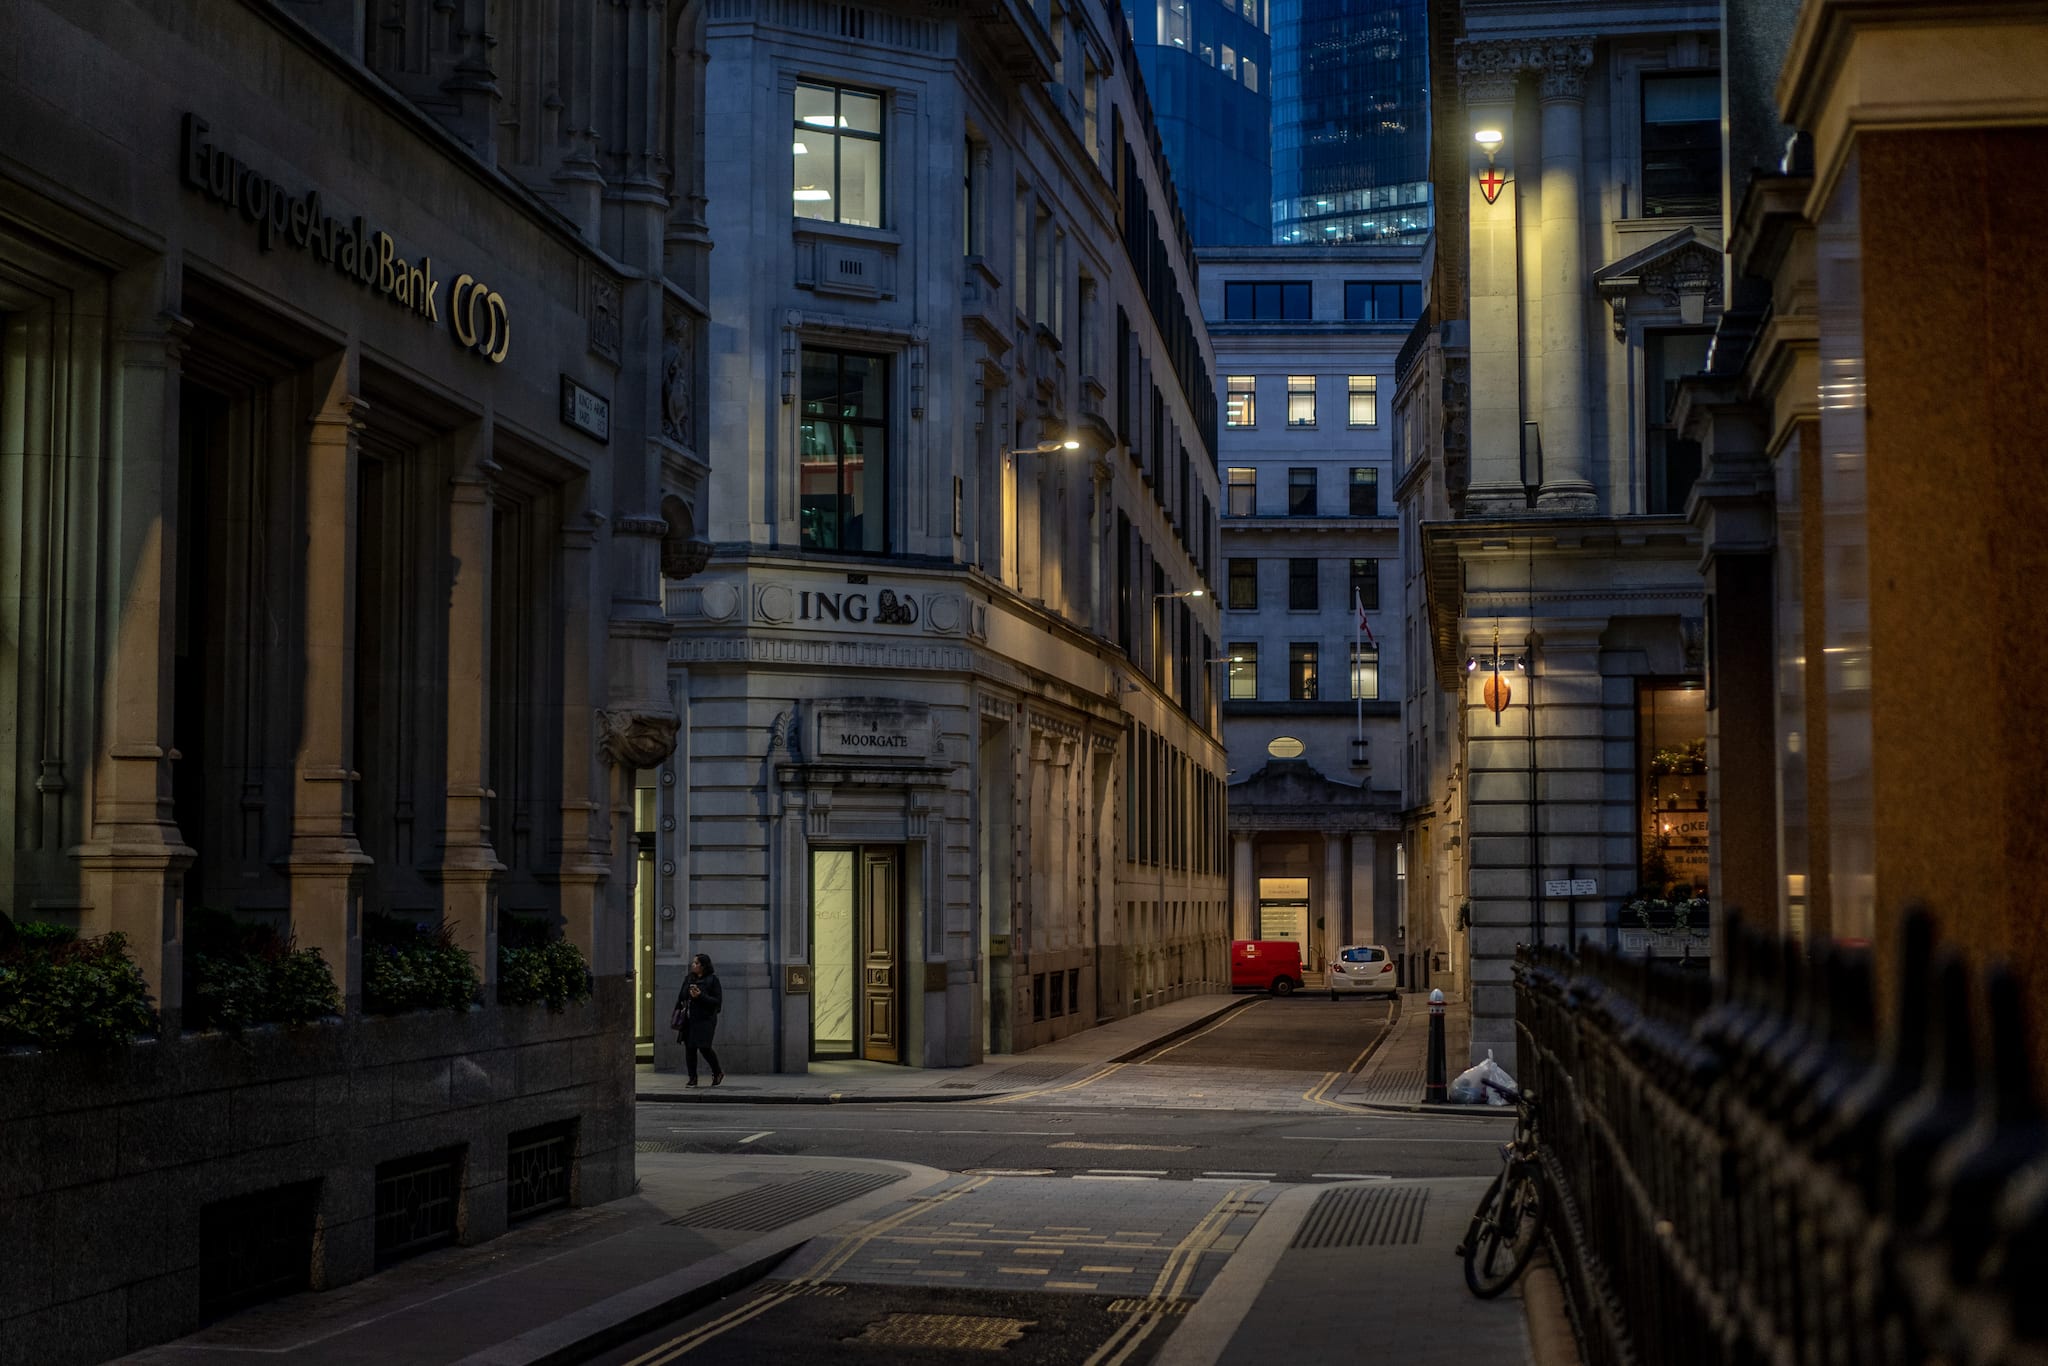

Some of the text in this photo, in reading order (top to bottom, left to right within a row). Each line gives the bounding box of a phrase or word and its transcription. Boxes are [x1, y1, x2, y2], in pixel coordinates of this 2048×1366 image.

[182, 112, 439, 322] EuropeArabBank
[799, 590, 869, 622] ING
[871, 720, 879, 732] 8
[841, 734, 908, 747] MOORGATE
